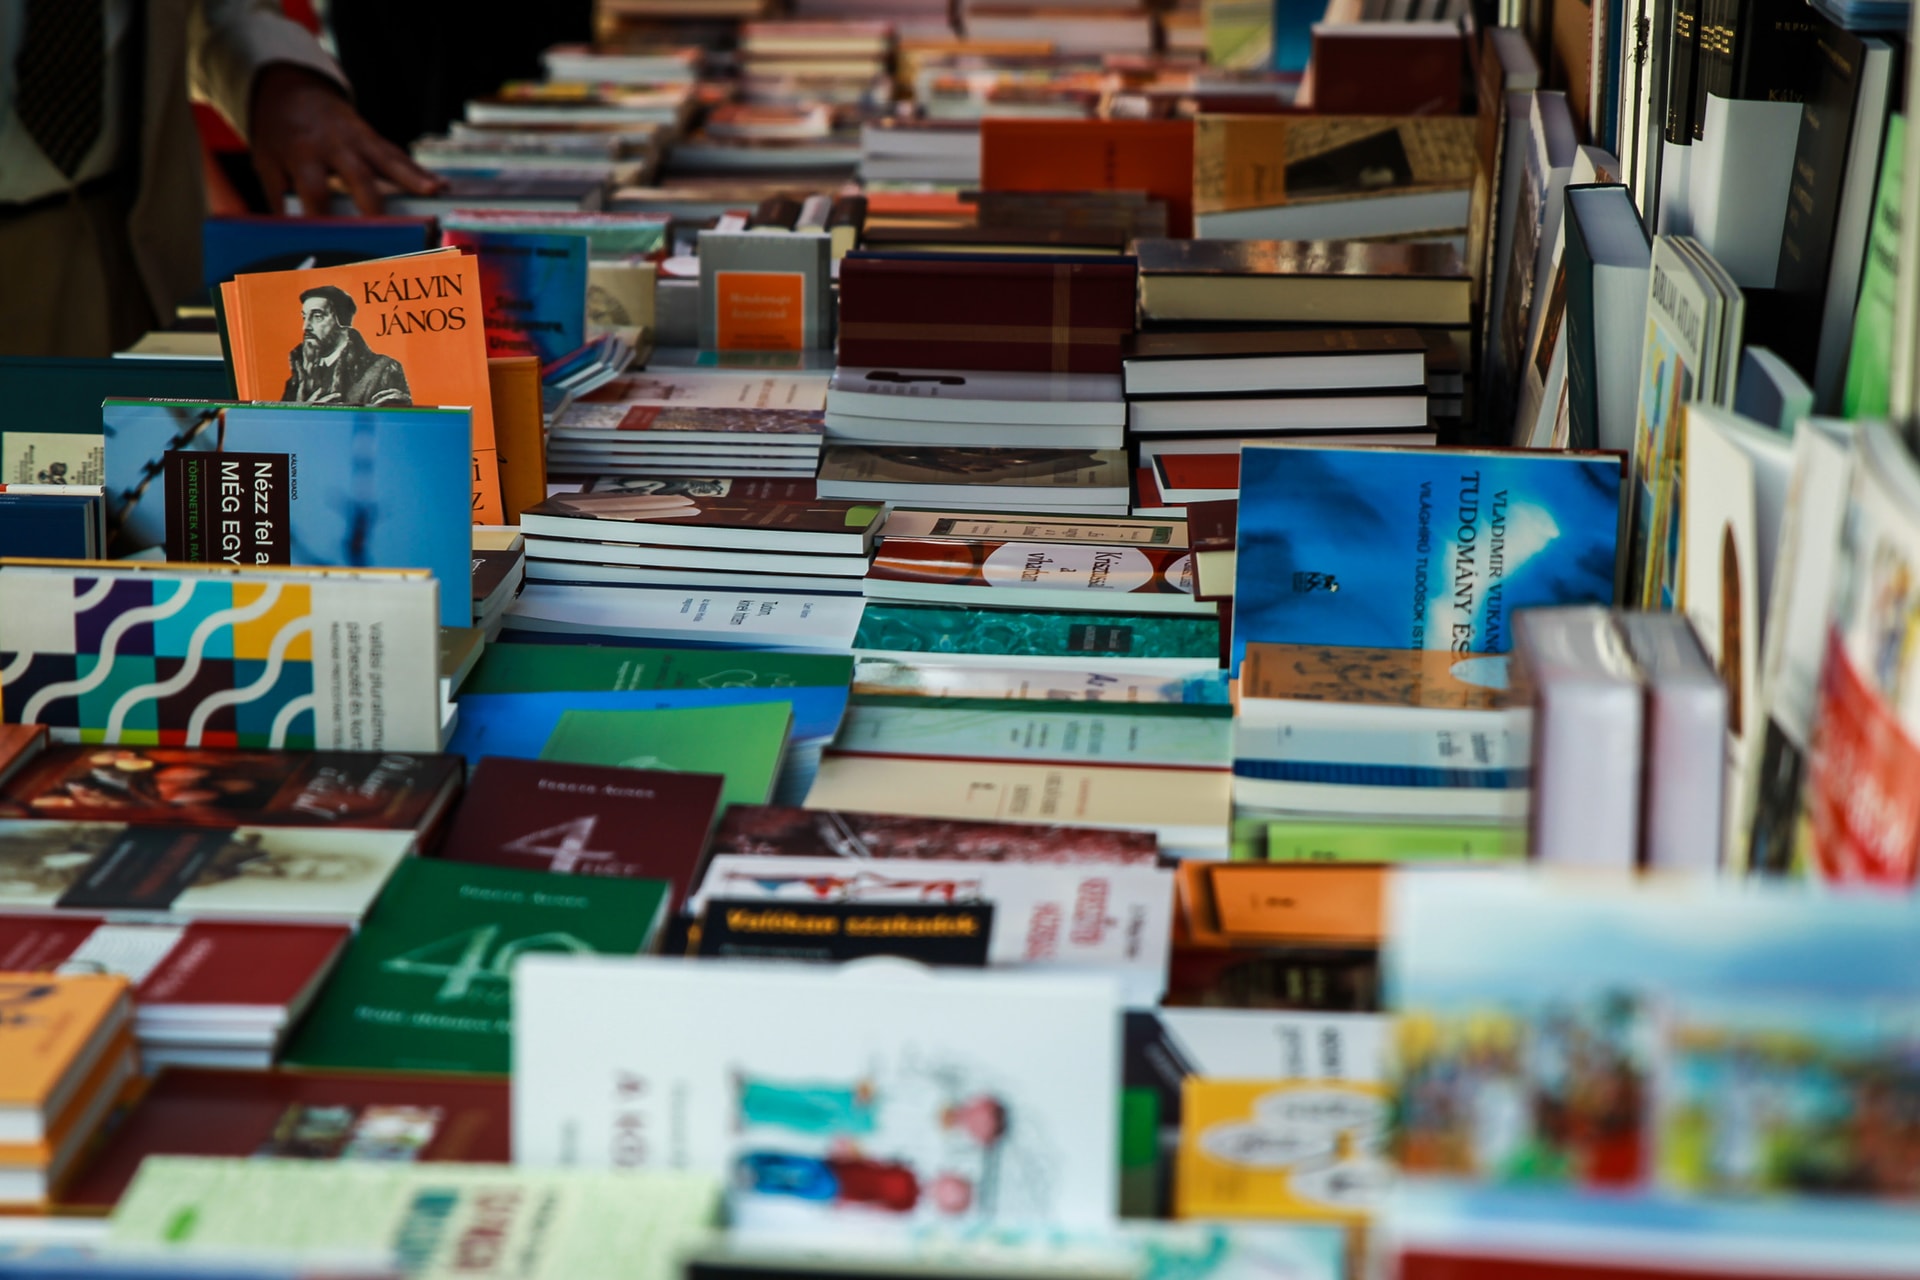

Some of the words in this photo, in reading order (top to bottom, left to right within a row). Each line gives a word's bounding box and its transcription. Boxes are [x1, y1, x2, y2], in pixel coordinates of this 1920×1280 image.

[363, 273, 463, 304] KÁLVIN
[376, 307, 467, 337] JÁNOS
[188, 460, 199, 530] TÖRTÉNETEK
[221, 461, 244, 513] MÉG
[254, 462, 273, 514] Nézz
[290, 479, 298, 500] KIADÓ
[222, 520, 241, 566] EGY
[254, 520, 273, 545] fel
[1453, 471, 1480, 614] TUDOMÁNY
[1488, 489, 1508, 579] VLADIMIR
[1414, 558, 1428, 621] TUDÓSOK
